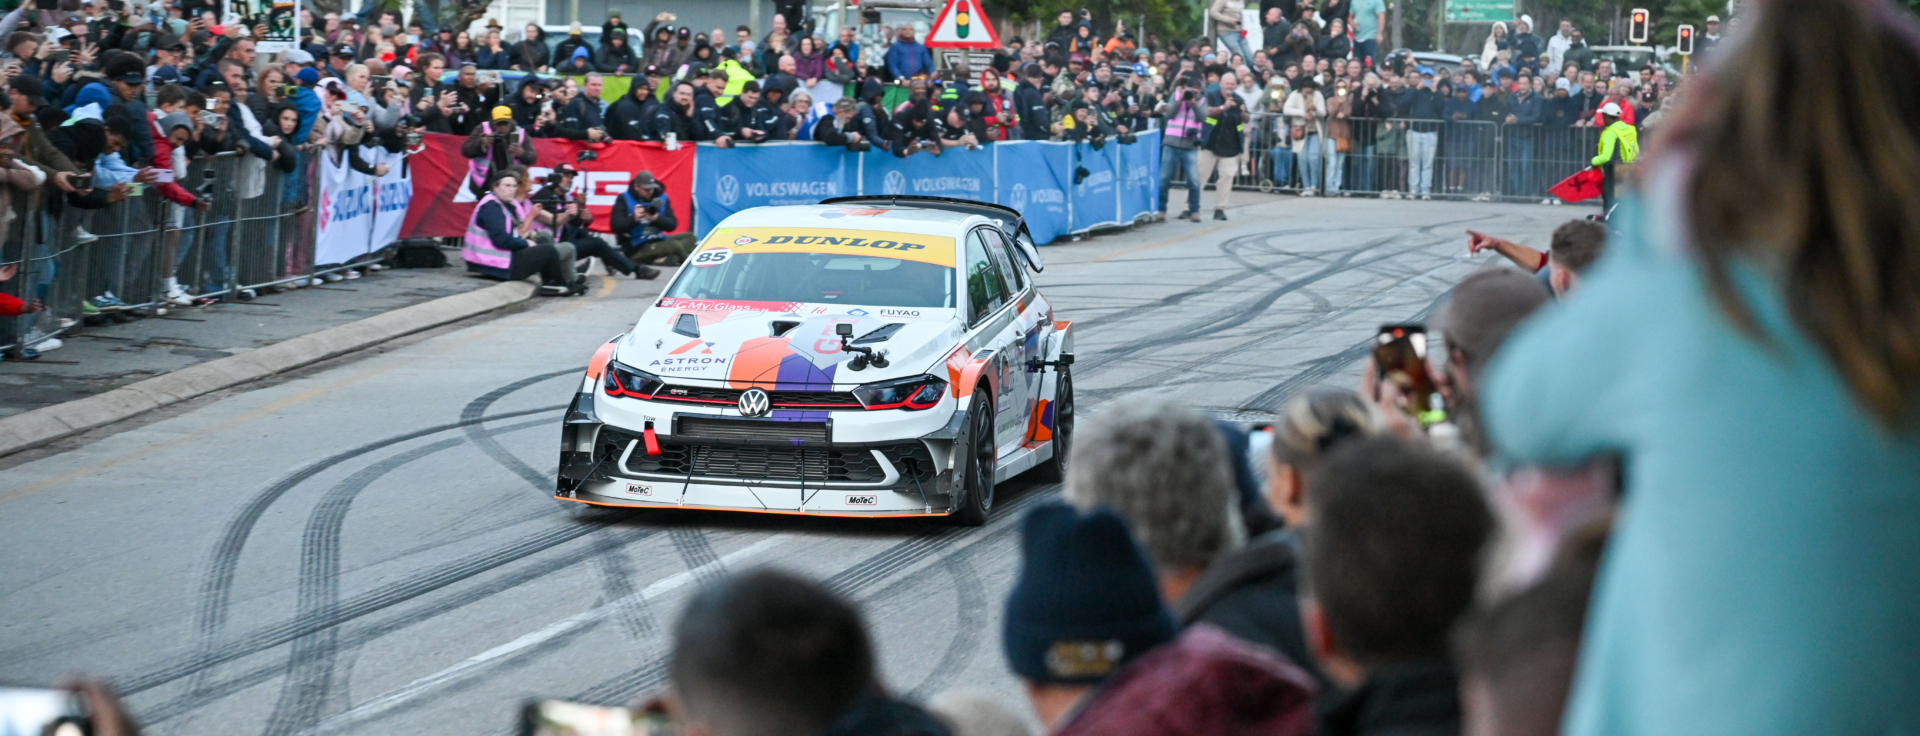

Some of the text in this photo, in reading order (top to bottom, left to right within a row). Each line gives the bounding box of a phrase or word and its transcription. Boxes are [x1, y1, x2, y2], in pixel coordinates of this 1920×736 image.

[745, 181, 837, 197] VOLKSWAGEN
[761, 236, 926, 251] DUNLOP
[695, 251, 728, 263] 85
[880, 309, 920, 317] FUYAO
[649, 357, 726, 366] ASTRON
[660, 365, 708, 373] ENERGY
[628, 485, 650, 494] MoTeC
[847, 495, 875, 504] MoTeC
